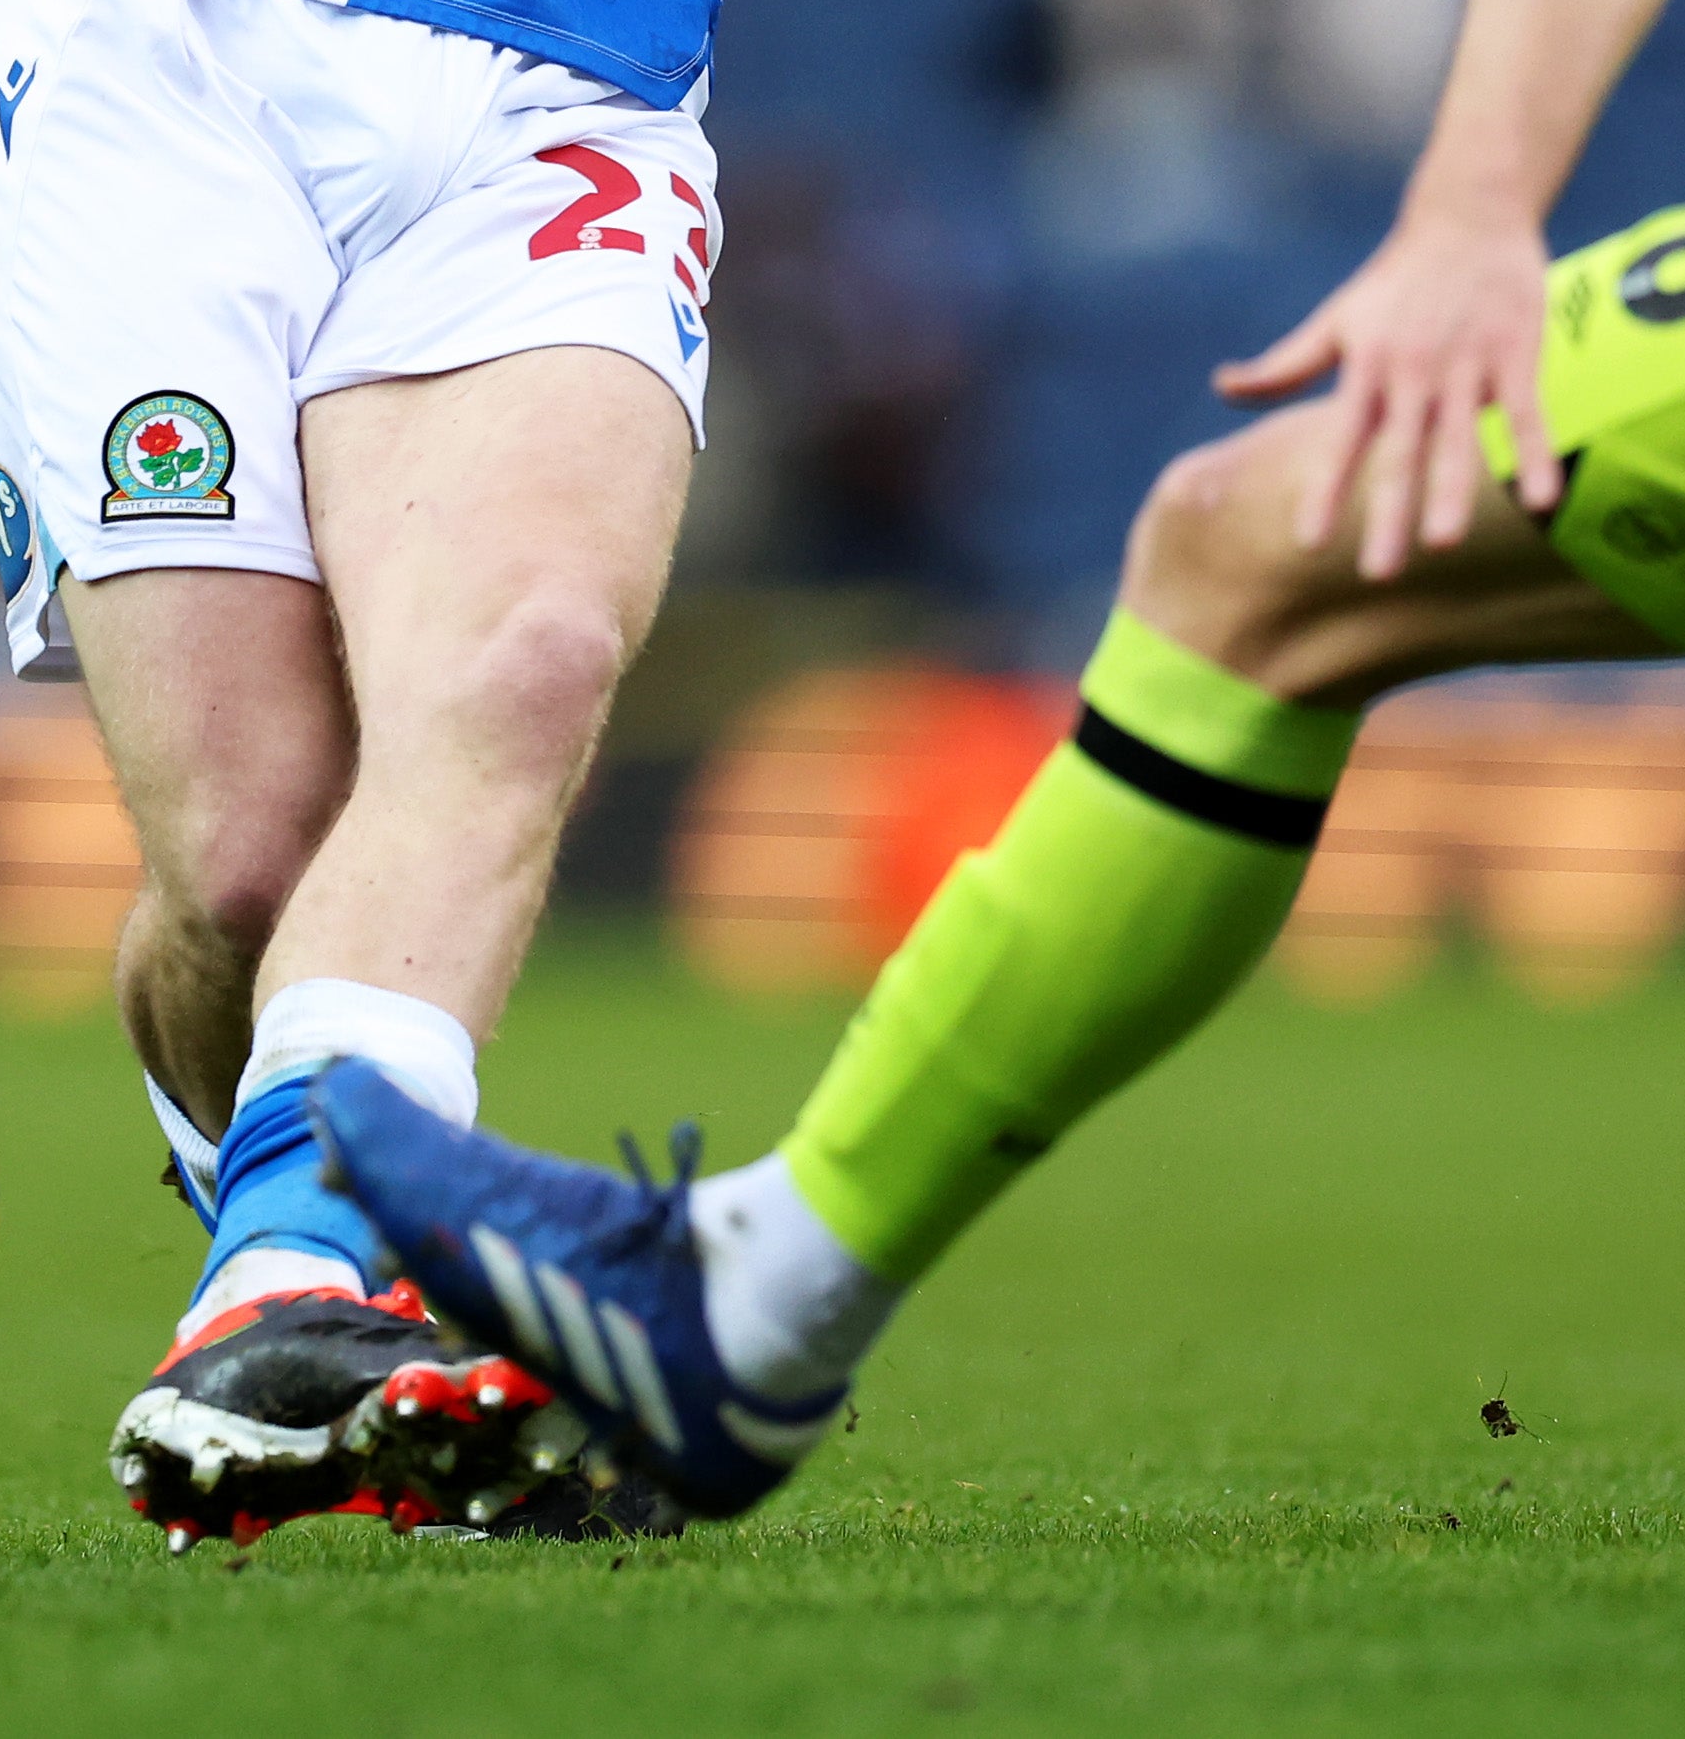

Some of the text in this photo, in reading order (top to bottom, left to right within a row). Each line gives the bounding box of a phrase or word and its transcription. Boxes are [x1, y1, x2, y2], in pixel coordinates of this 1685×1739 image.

[111, 400, 167, 480] BLACKBURN
[172, 401, 225, 447] ROVERS
[112, 500, 222, 512] ARTE ET LABORE
